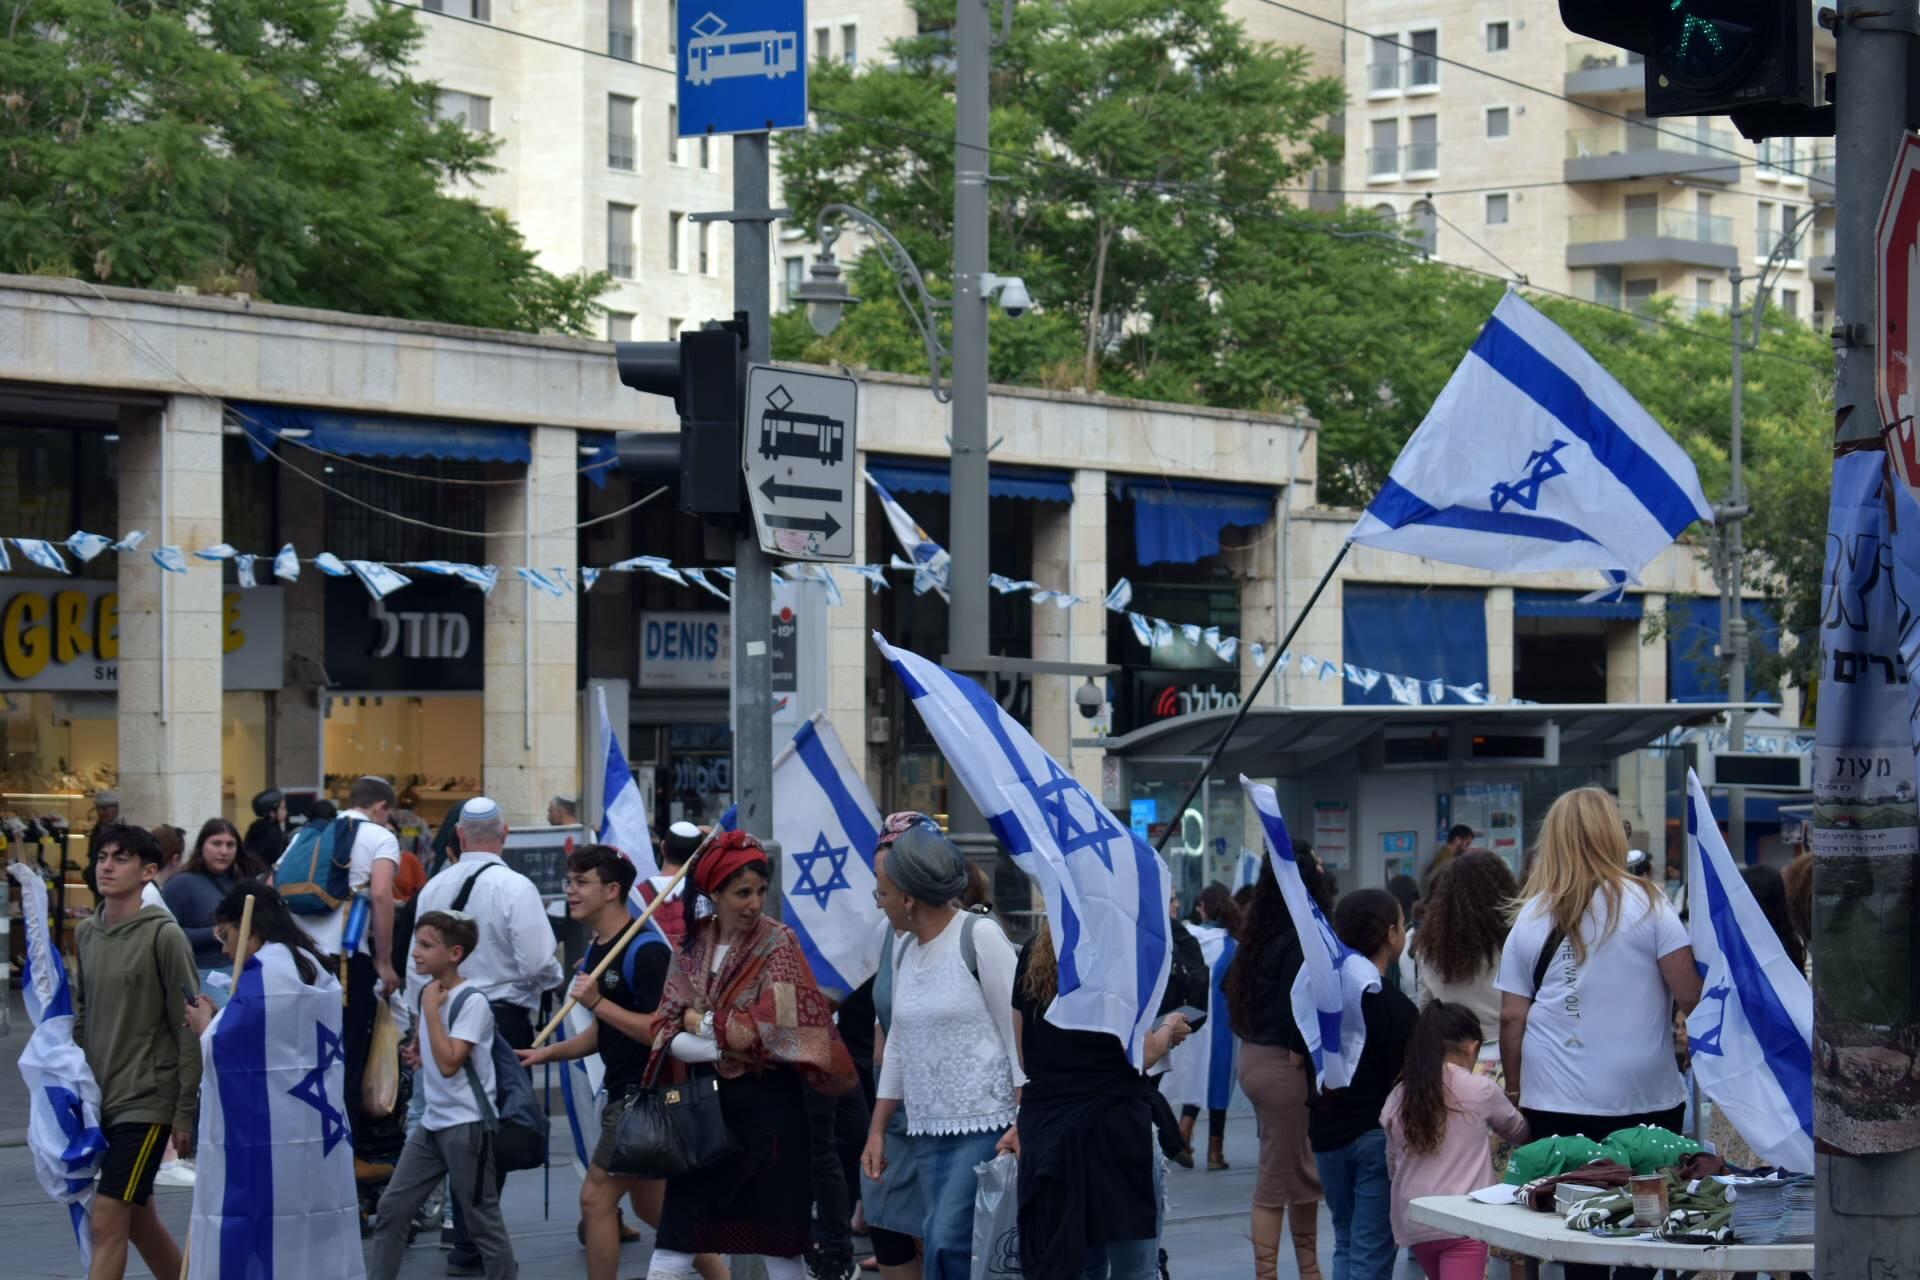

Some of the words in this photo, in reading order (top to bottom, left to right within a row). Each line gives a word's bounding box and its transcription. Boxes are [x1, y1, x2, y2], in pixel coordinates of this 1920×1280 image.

[372, 600, 470, 658] מודל
[646, 620, 719, 660] DENIS
[1836, 757, 1891, 779] מעוז
[1562, 938, 1576, 960] HE
[1564, 966, 1577, 991] WAY
[1565, 995, 1581, 1018] OUT
